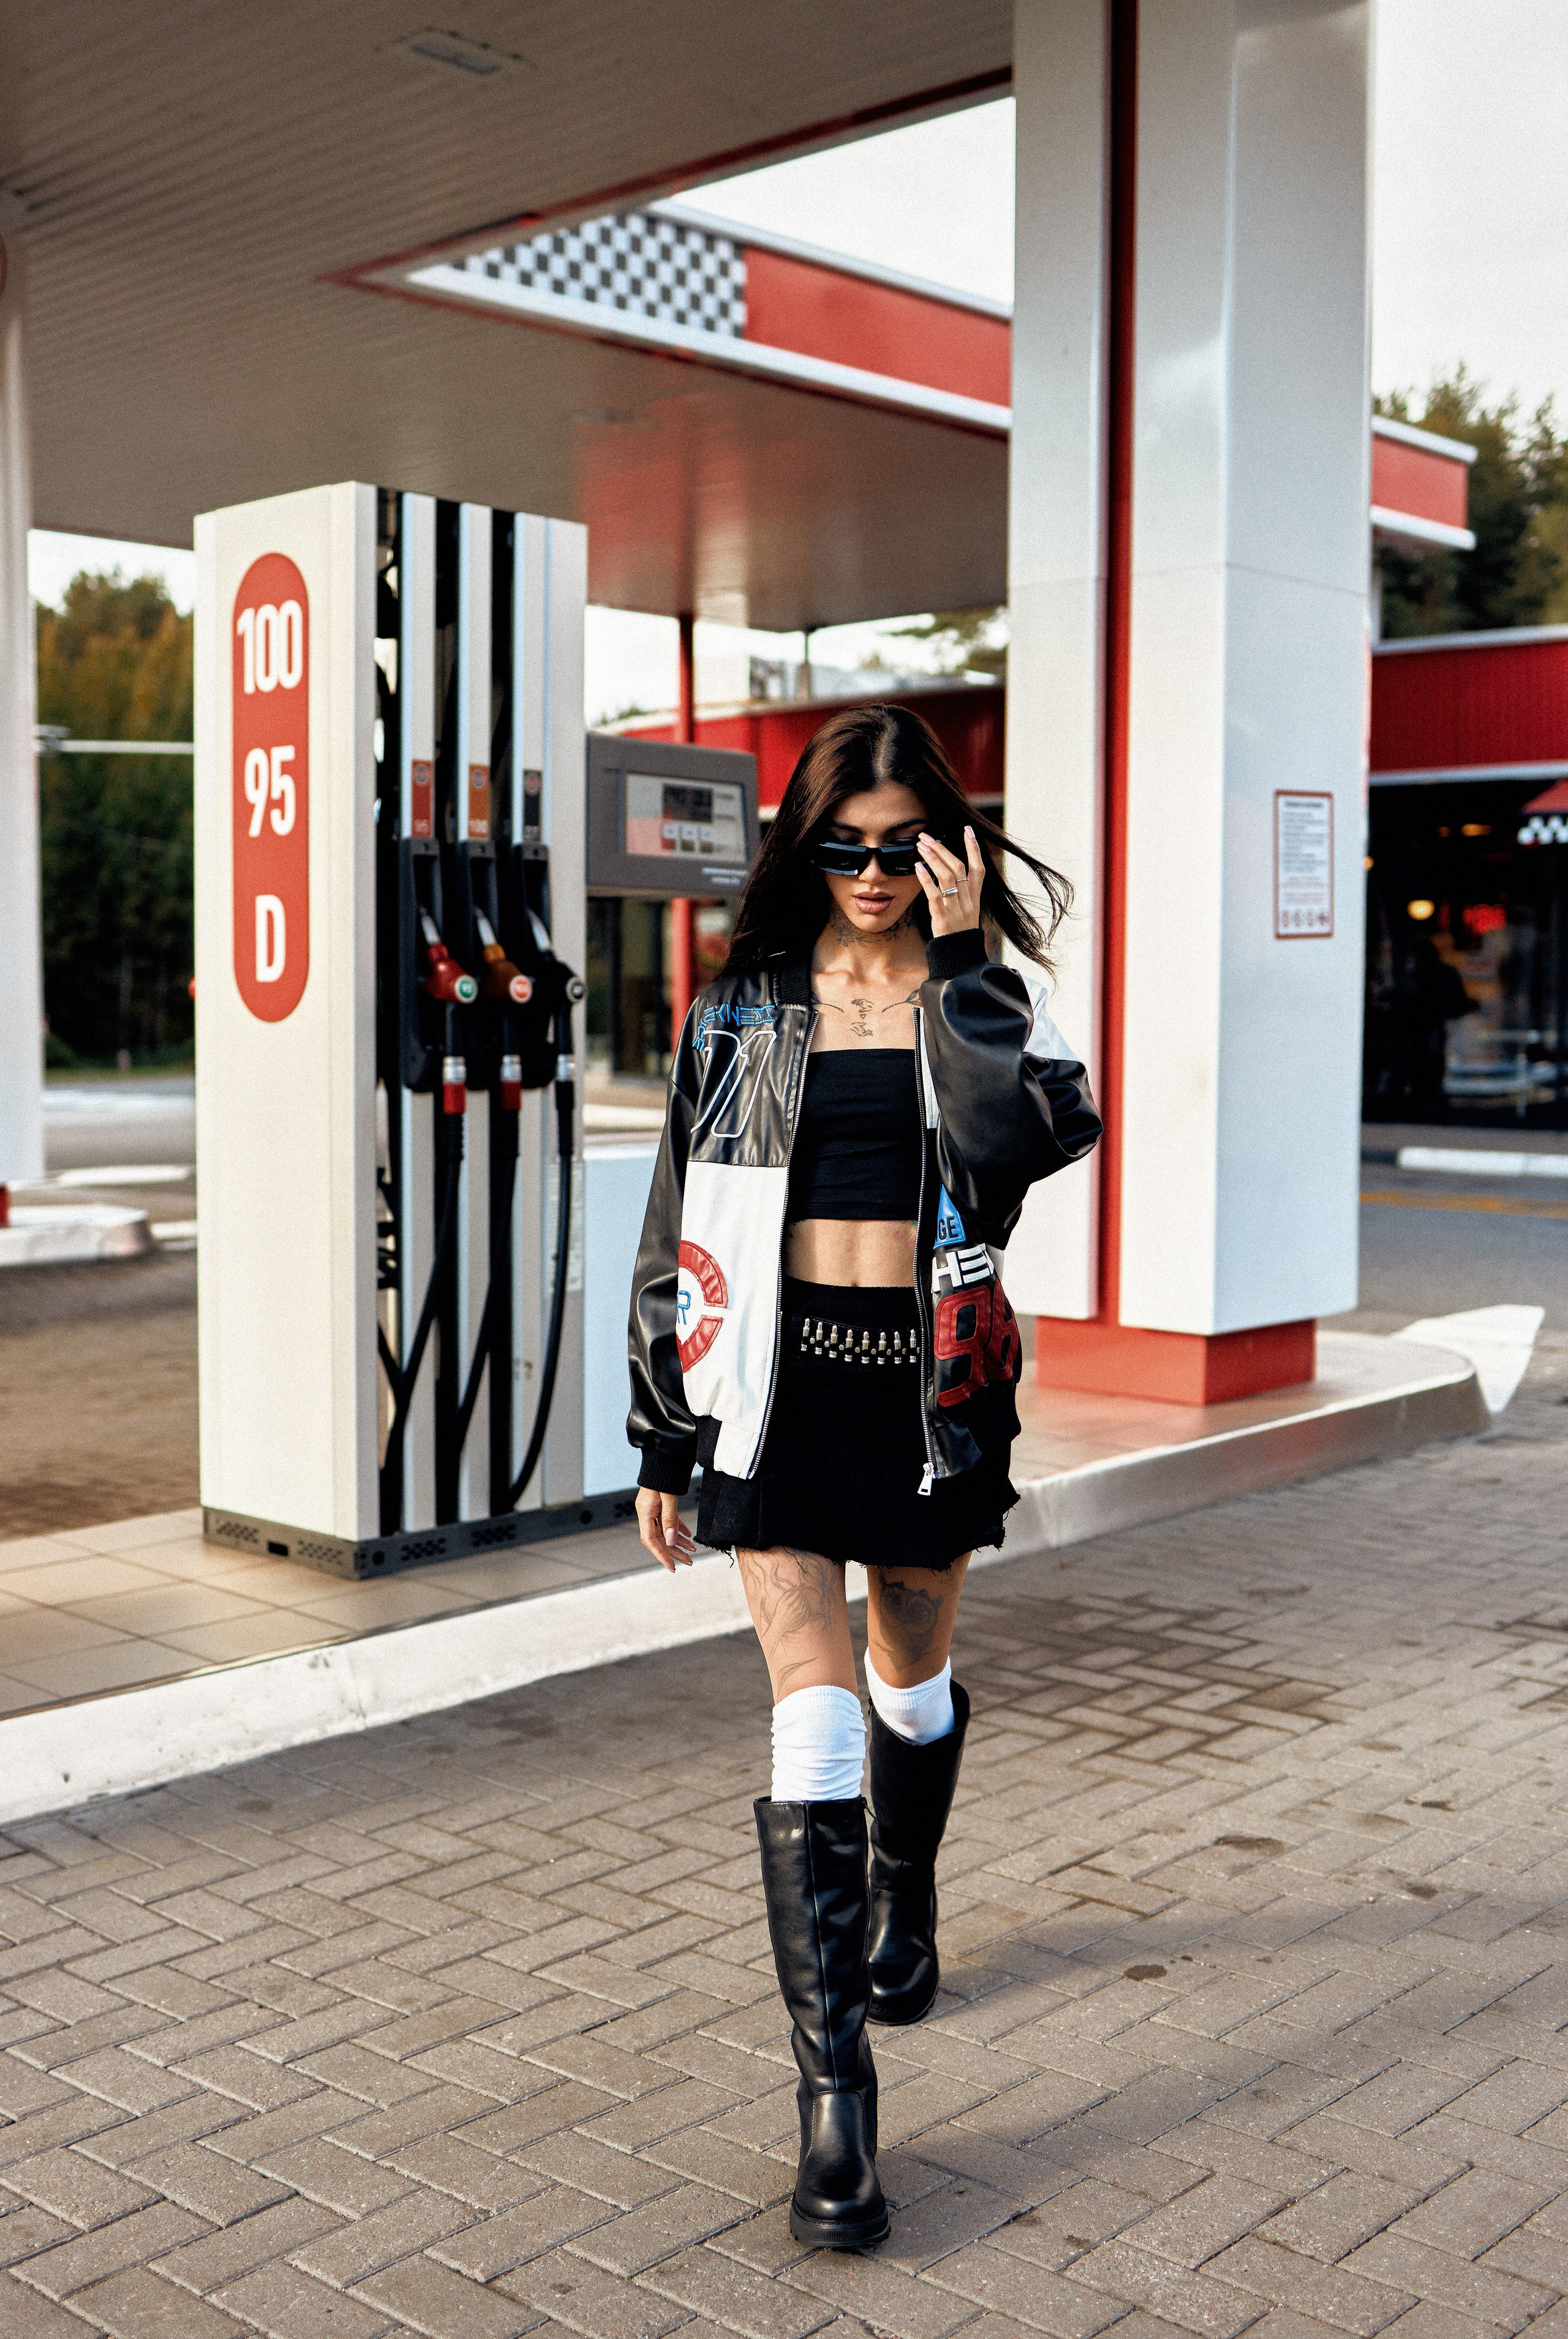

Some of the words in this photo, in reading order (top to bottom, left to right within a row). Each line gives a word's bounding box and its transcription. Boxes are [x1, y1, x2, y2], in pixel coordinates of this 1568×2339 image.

[237, 600, 304, 693] 100
[245, 745, 296, 837] 95
[255, 894, 287, 983] D
[931, 1243, 995, 1293] HE
[935, 1215, 959, 1242] GE
